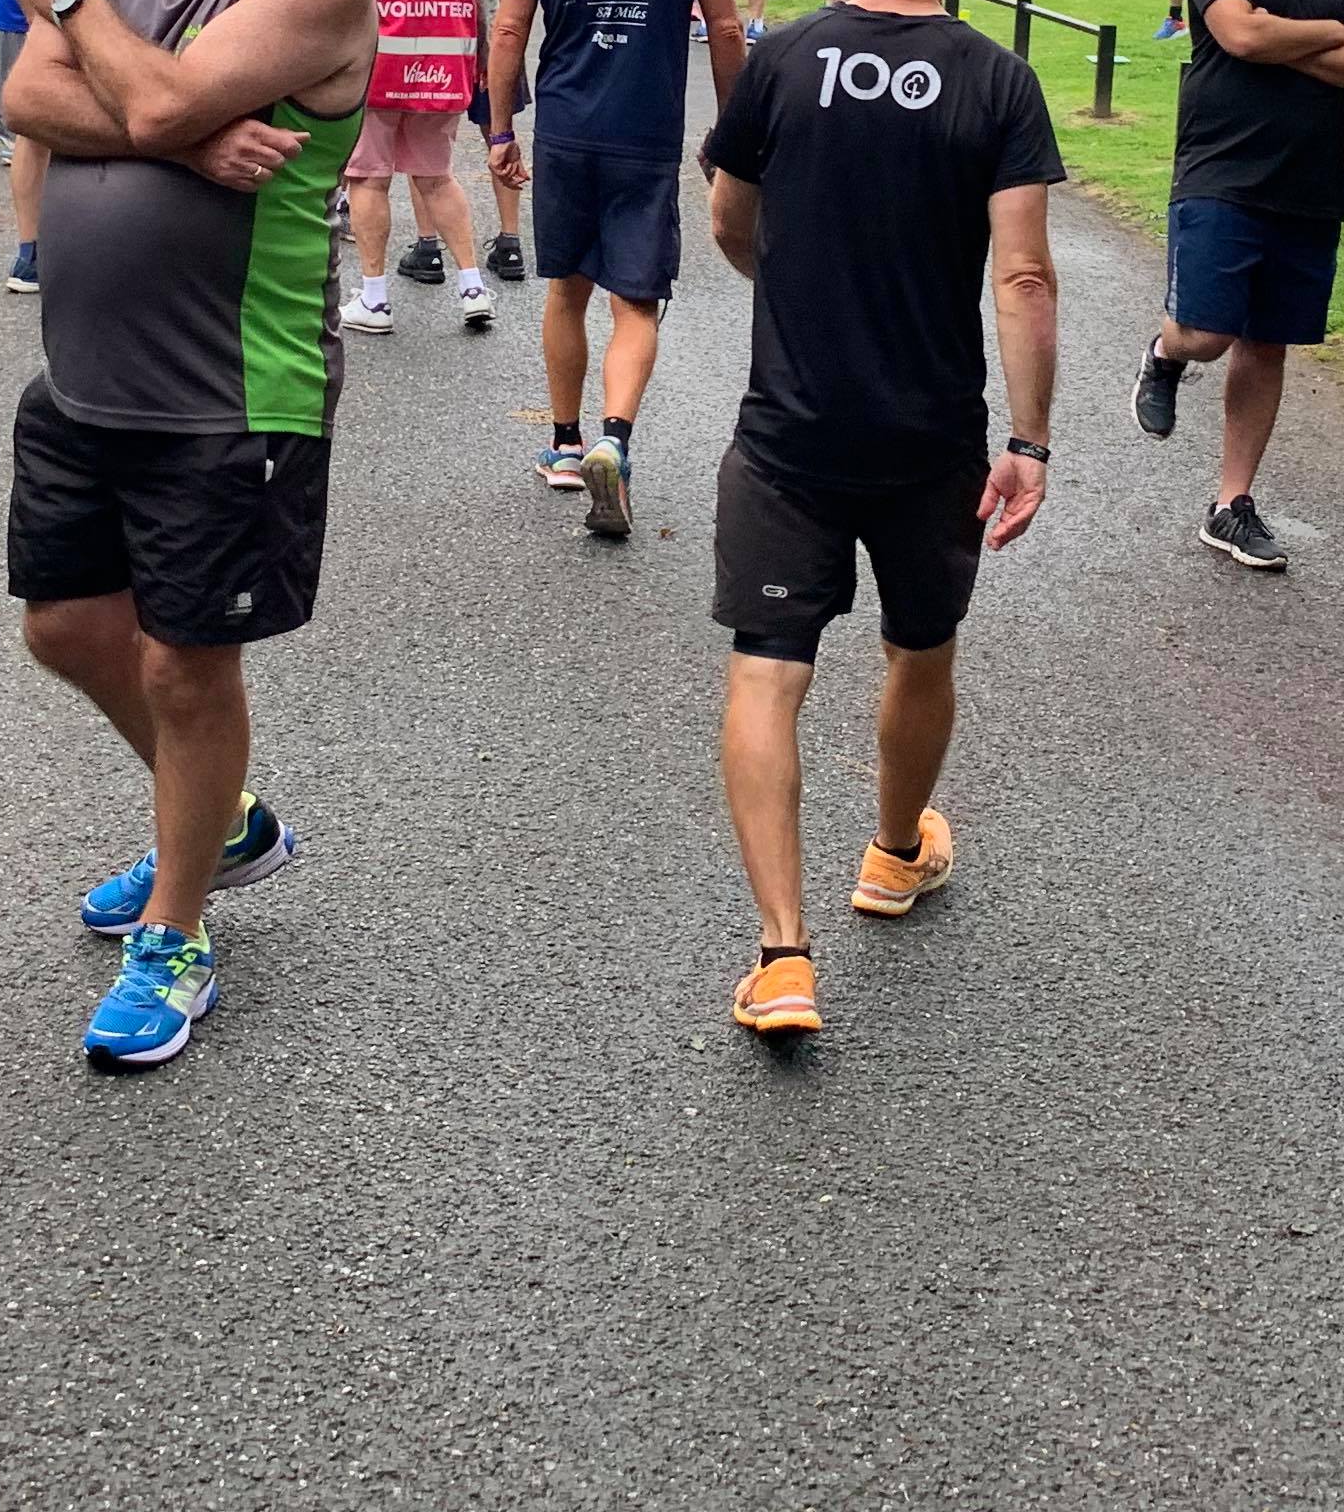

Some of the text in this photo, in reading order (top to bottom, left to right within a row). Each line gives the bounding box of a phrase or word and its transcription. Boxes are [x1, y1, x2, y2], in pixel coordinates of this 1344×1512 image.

[376, 0, 474, 18] VOLUNTEER
[613, 5, 648, 20] Miles
[403, 60, 452, 90] Vitality
[816, 46, 942, 110] 100
